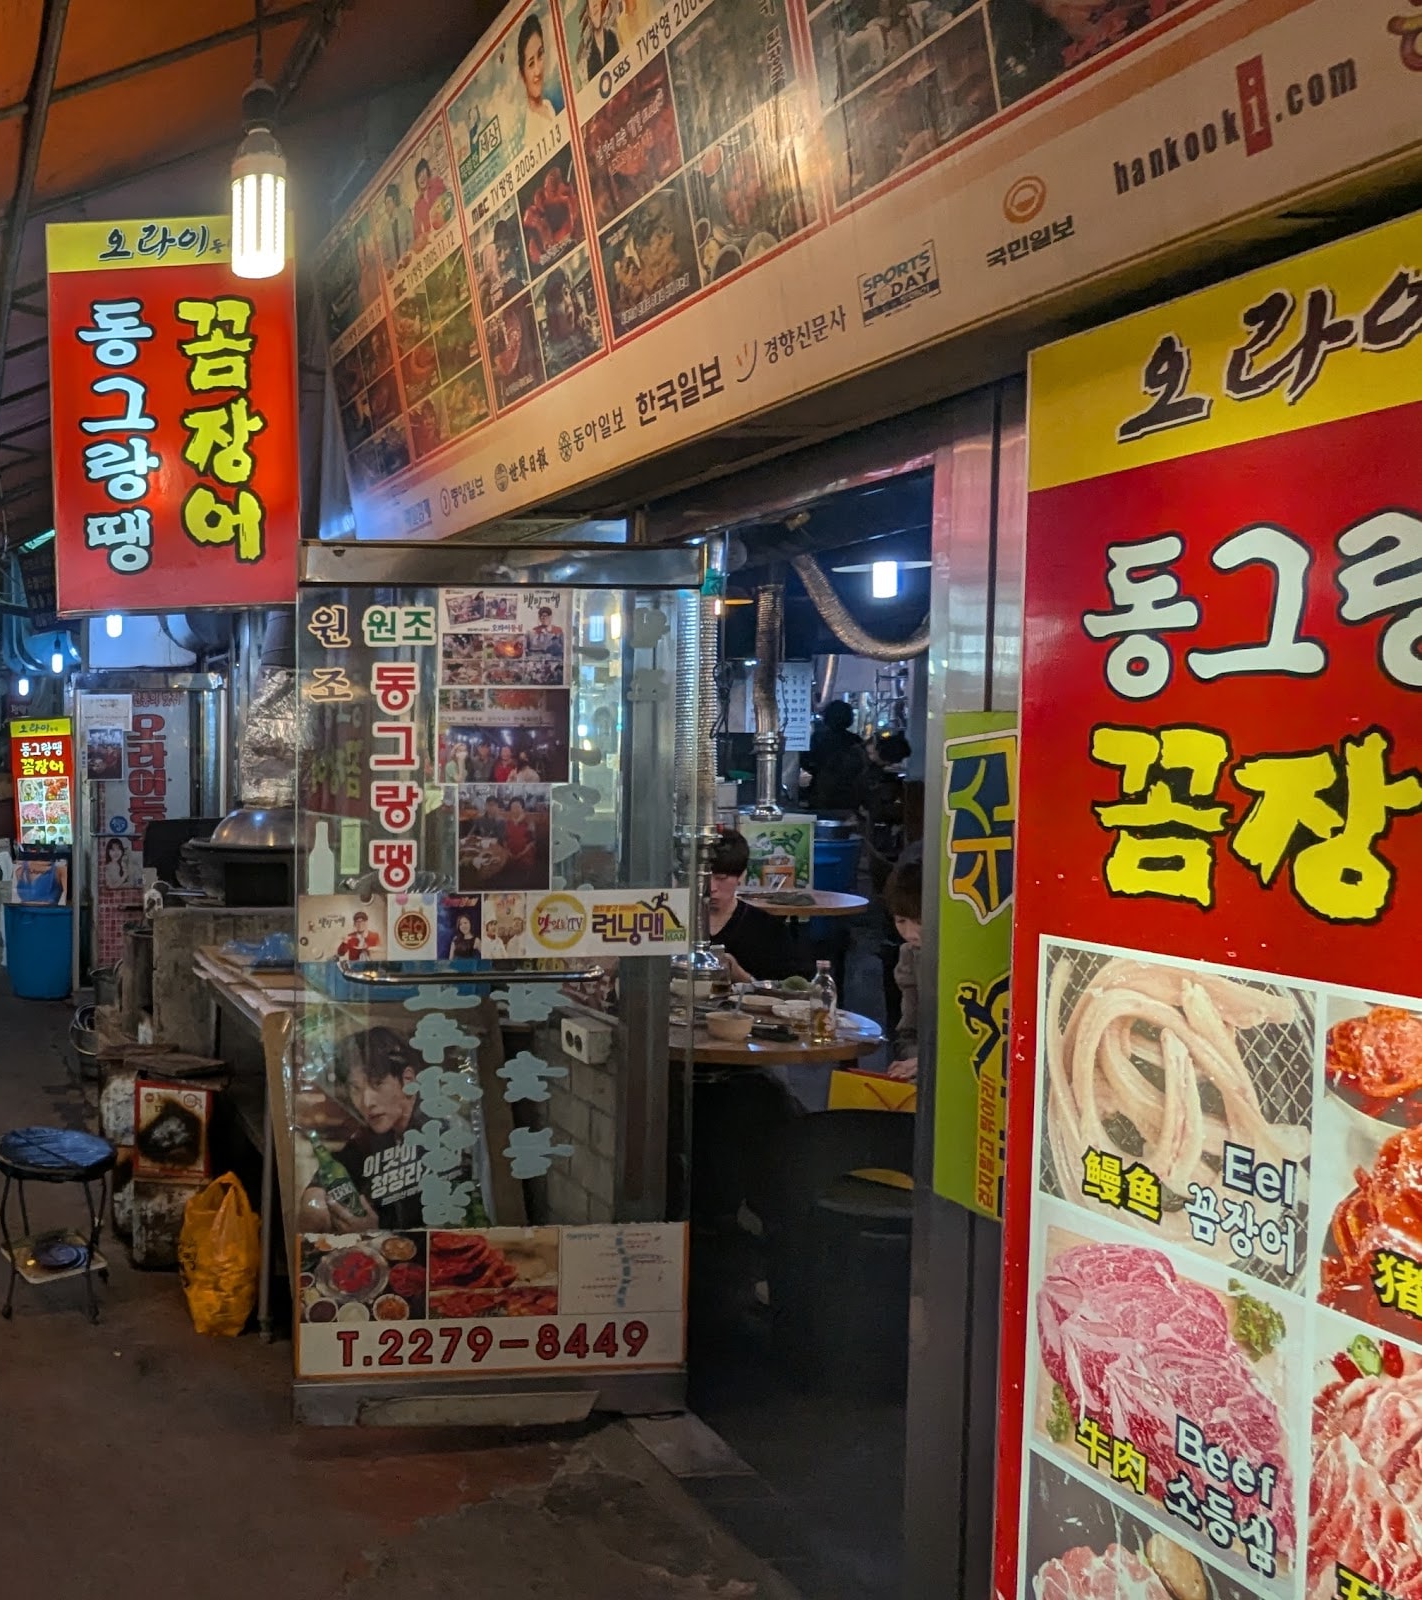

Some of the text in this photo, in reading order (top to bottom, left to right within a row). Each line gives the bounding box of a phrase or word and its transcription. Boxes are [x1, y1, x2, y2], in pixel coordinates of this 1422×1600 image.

[612, 55, 631, 84] SBS
[514, 123, 562, 183] 2005.11.13
[97, 223, 210, 262] 오라이
[986, 215, 1076, 269] 국민일보
[861, 250, 930, 294] SPORTS
[764, 305, 847, 365] 경향신문사
[635, 356, 725, 428] 한국일보
[77, 299, 161, 574] 동그랑땡
[176, 298, 264, 561] 꼼장어
[571, 406, 626, 453] 동아일보
[450, 475, 486, 510] 중앙일보
[364, 606, 436, 646] 원조
[309, 605, 354, 702] 원조
[18, 721, 50, 734] 오라이
[20, 740, 63, 758] 동그랑땡
[20, 758, 65, 776] 꼼장어
[370, 662, 423, 892] 동그랑땡
[568, 916, 584, 932] TV
[591, 911, 665, 946] 런닝맨
[362, 1141, 418, 1178] 이 맛이
[1223, 1141, 1296, 1208] Eel
[1185, 1183, 1297, 1275] 꼼장어
[336, 1319, 650, 1368] T.2279-8449
[1077, 1419, 1148, 1493] 牛肉
[1176, 1418, 1275, 1504] Beef
[1164, 1475, 1277, 1573] 소등심
